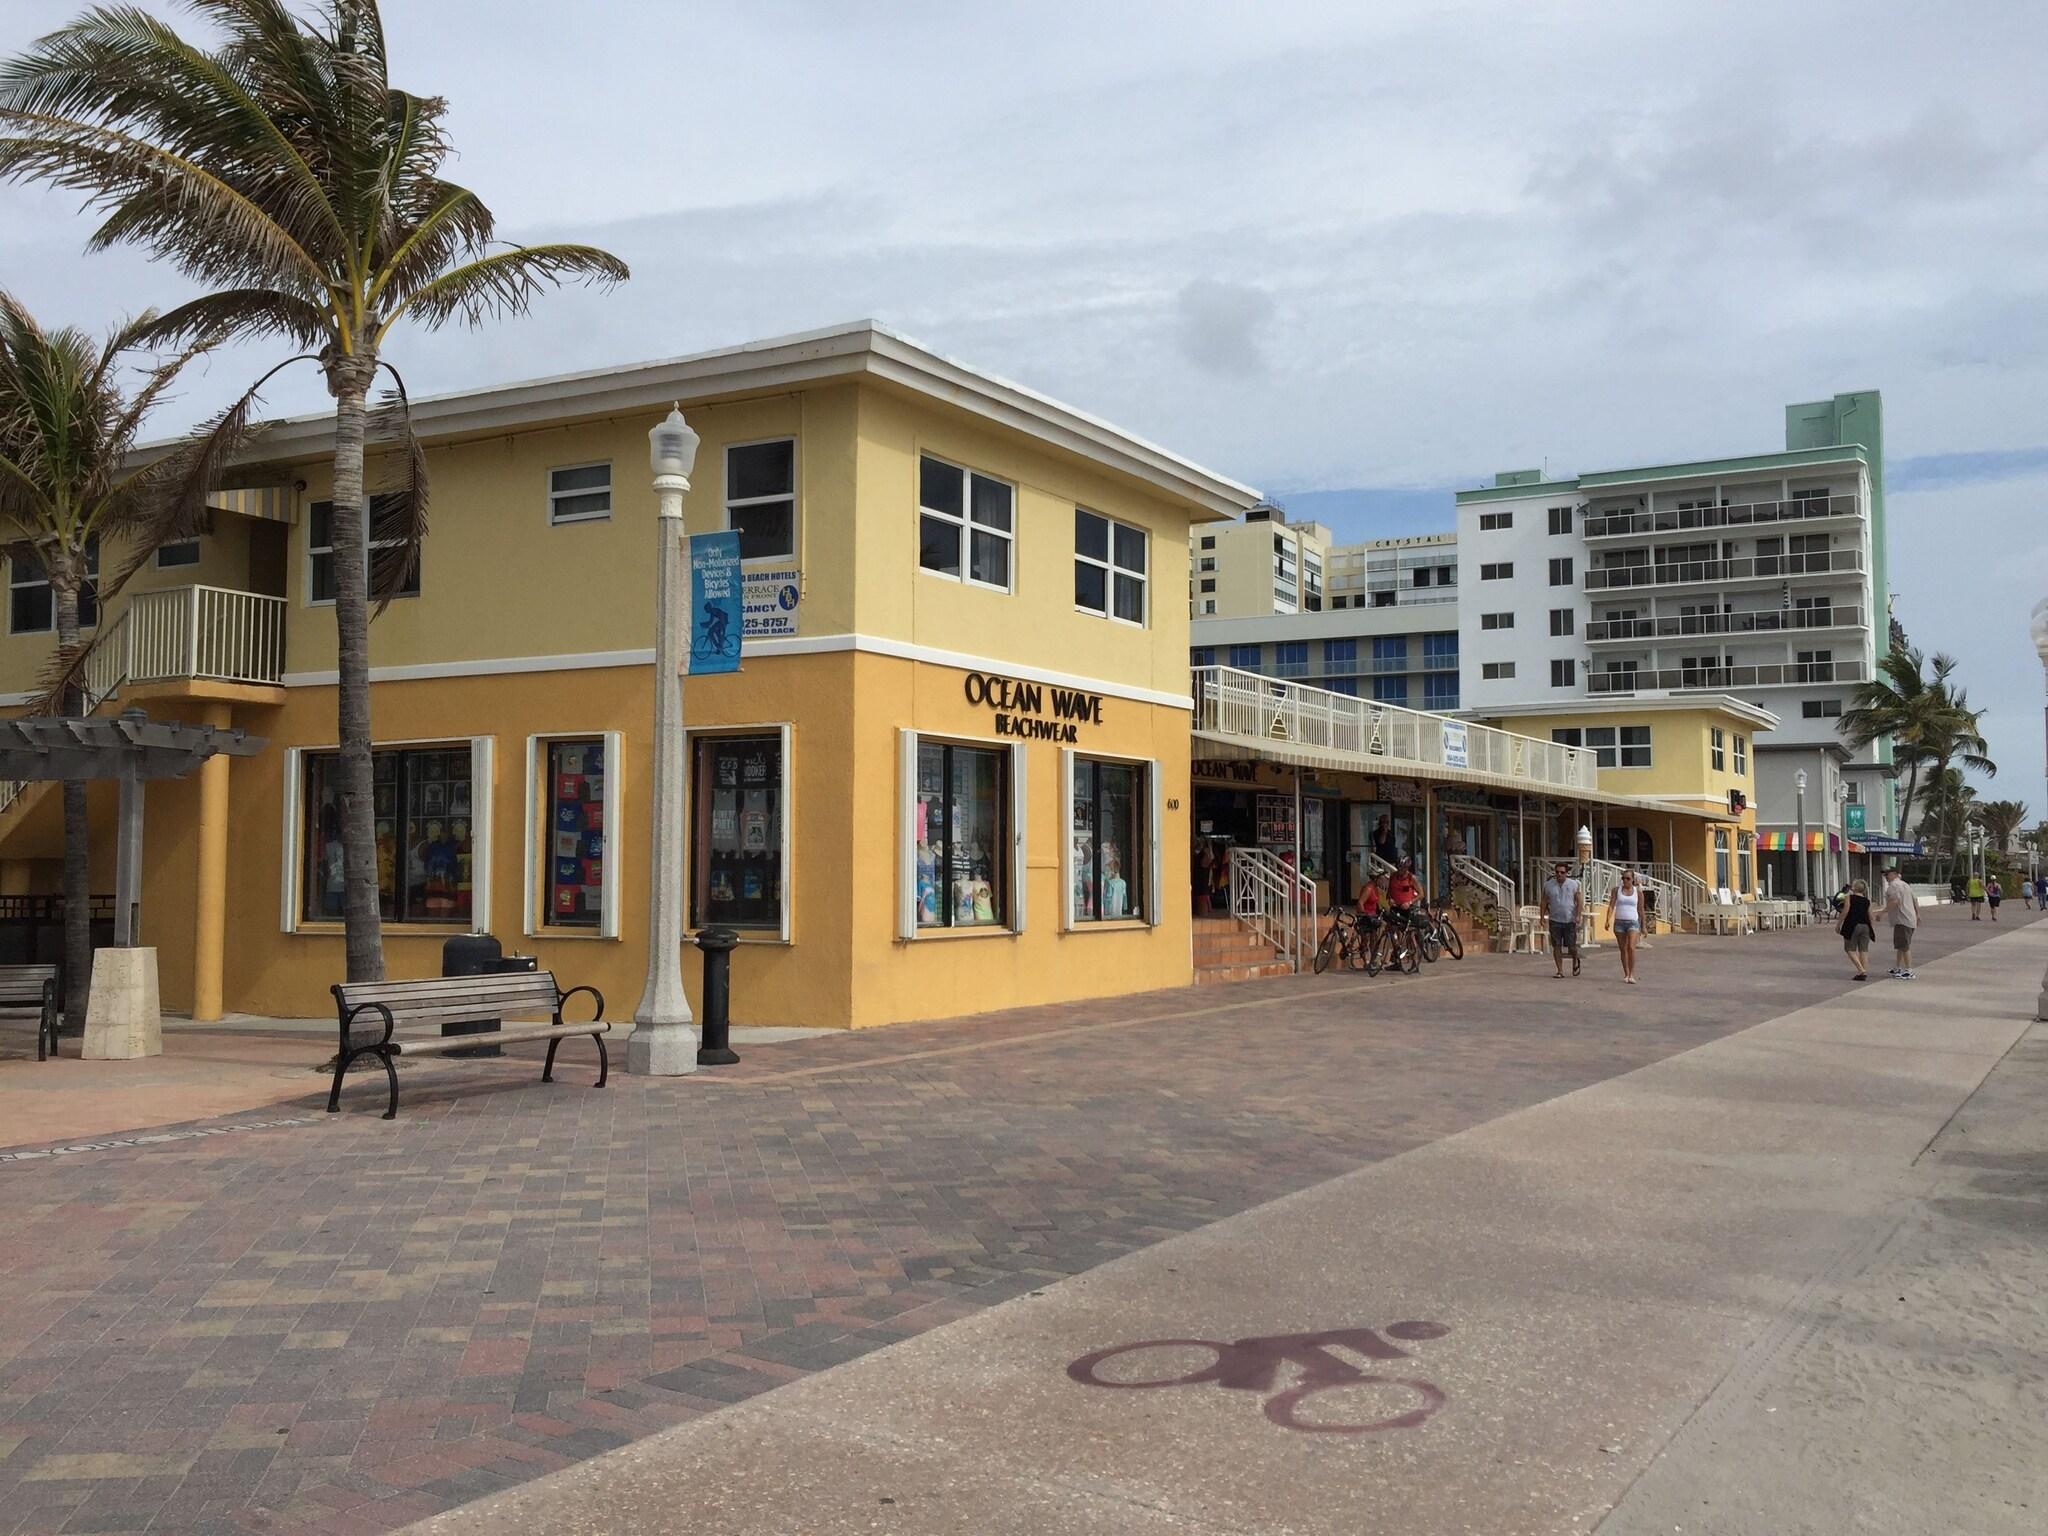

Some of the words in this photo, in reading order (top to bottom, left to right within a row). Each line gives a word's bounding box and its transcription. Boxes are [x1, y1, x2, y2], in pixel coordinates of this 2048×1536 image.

[1375, 535, 1440, 548] CRYSTAL
[693, 556, 739, 570] Non-Motorized
[702, 569, 725, 579] Devices
[726, 567, 732, 577] &
[747, 573, 770, 582] BEACH
[771, 571, 797, 580] HOTELS
[704, 578, 729, 590] Bicycles
[743, 585, 780, 594] ERRACE
[704, 588, 731, 600] Allowed
[742, 604, 777, 613] CANCY
[744, 617, 788, 628] 25-8757
[964, 672, 1042, 714] OCEAN
[1050, 688, 1103, 725] WAVE
[995, 713, 1078, 744] BEACHWEAR
[1191, 760, 1227, 779] OCEAN
[1167, 798, 1179, 811] 600
